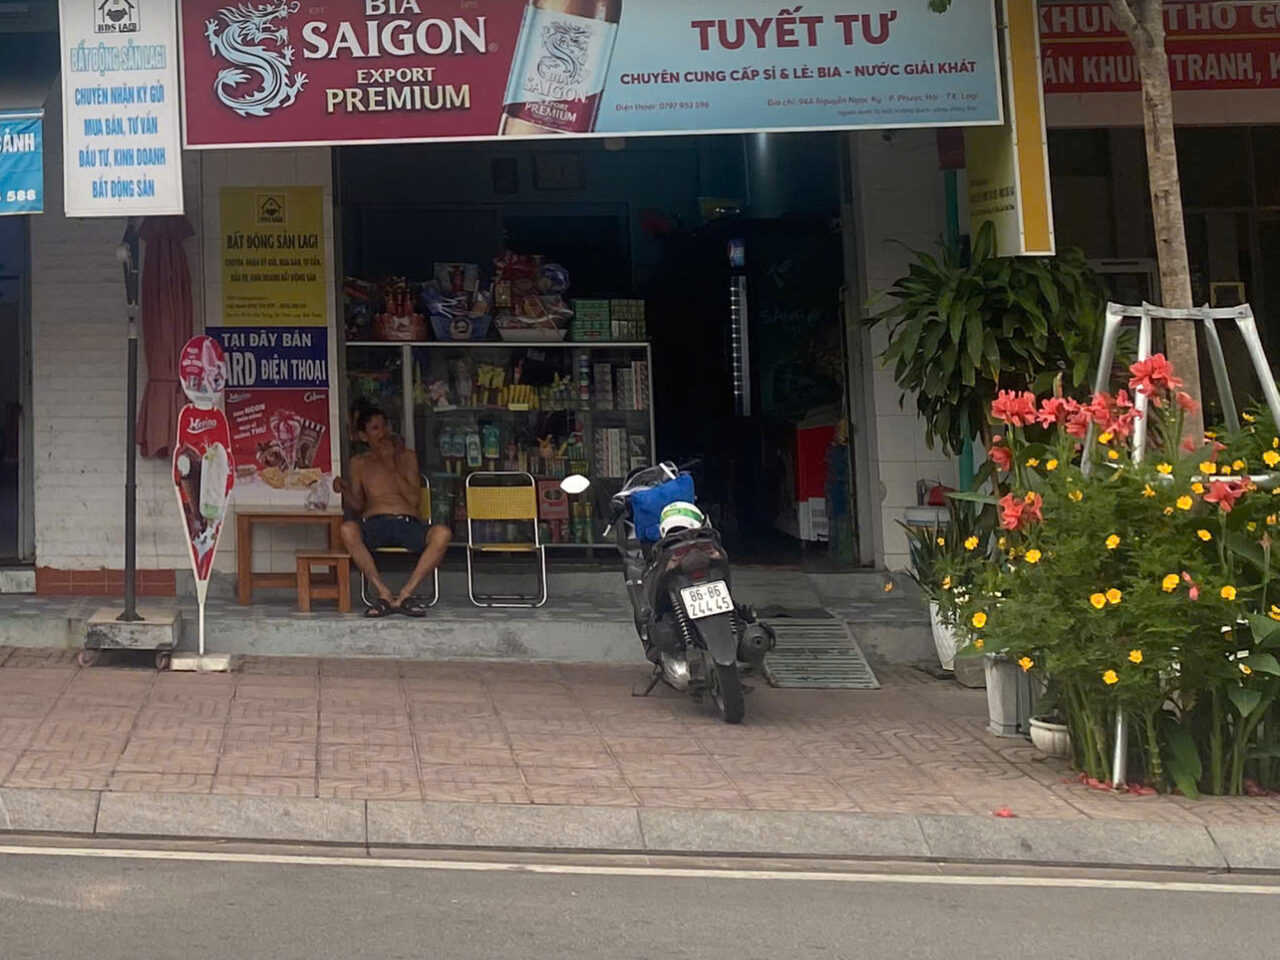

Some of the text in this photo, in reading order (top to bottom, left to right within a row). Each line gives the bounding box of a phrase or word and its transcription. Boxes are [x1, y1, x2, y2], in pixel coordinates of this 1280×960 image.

[302, 16, 486, 58] SAIGON
[691, 5, 897, 51] TUYẾT TƯ
[70, 39, 90, 72] BẤT
[91, 40, 119, 76] ĐỘNG
[120, 38, 141, 70] SẢN
[356, 67, 435, 83] EXPORT
[620, 70, 679, 84] CHUYÊN
[684, 71, 726, 82] CUNG
[730, 65, 759, 81] CẤP
[818, 67, 841, 78] BIA
[855, 61, 899, 76] NƯỚC
[904, 60, 934, 75] GIẢI
[938, 58, 976, 74] KHÁT
[1171, 52, 1262, 85] TRANH,
[75, 84, 108, 105] CHUYÊN
[326, 85, 470, 112] PREMIUM
[525, 103, 576, 122] PREMIUM
[84, 118, 103, 136] MUA
[114, 147, 165, 166] KINH DOANH
[7, 189, 36, 202] 588
[298, 234, 318, 248] LAGI
[221, 330, 311, 349] TẠI ĐÂY BÁN
[224, 351, 326, 385] ARD ĐIỆN THOẠI
